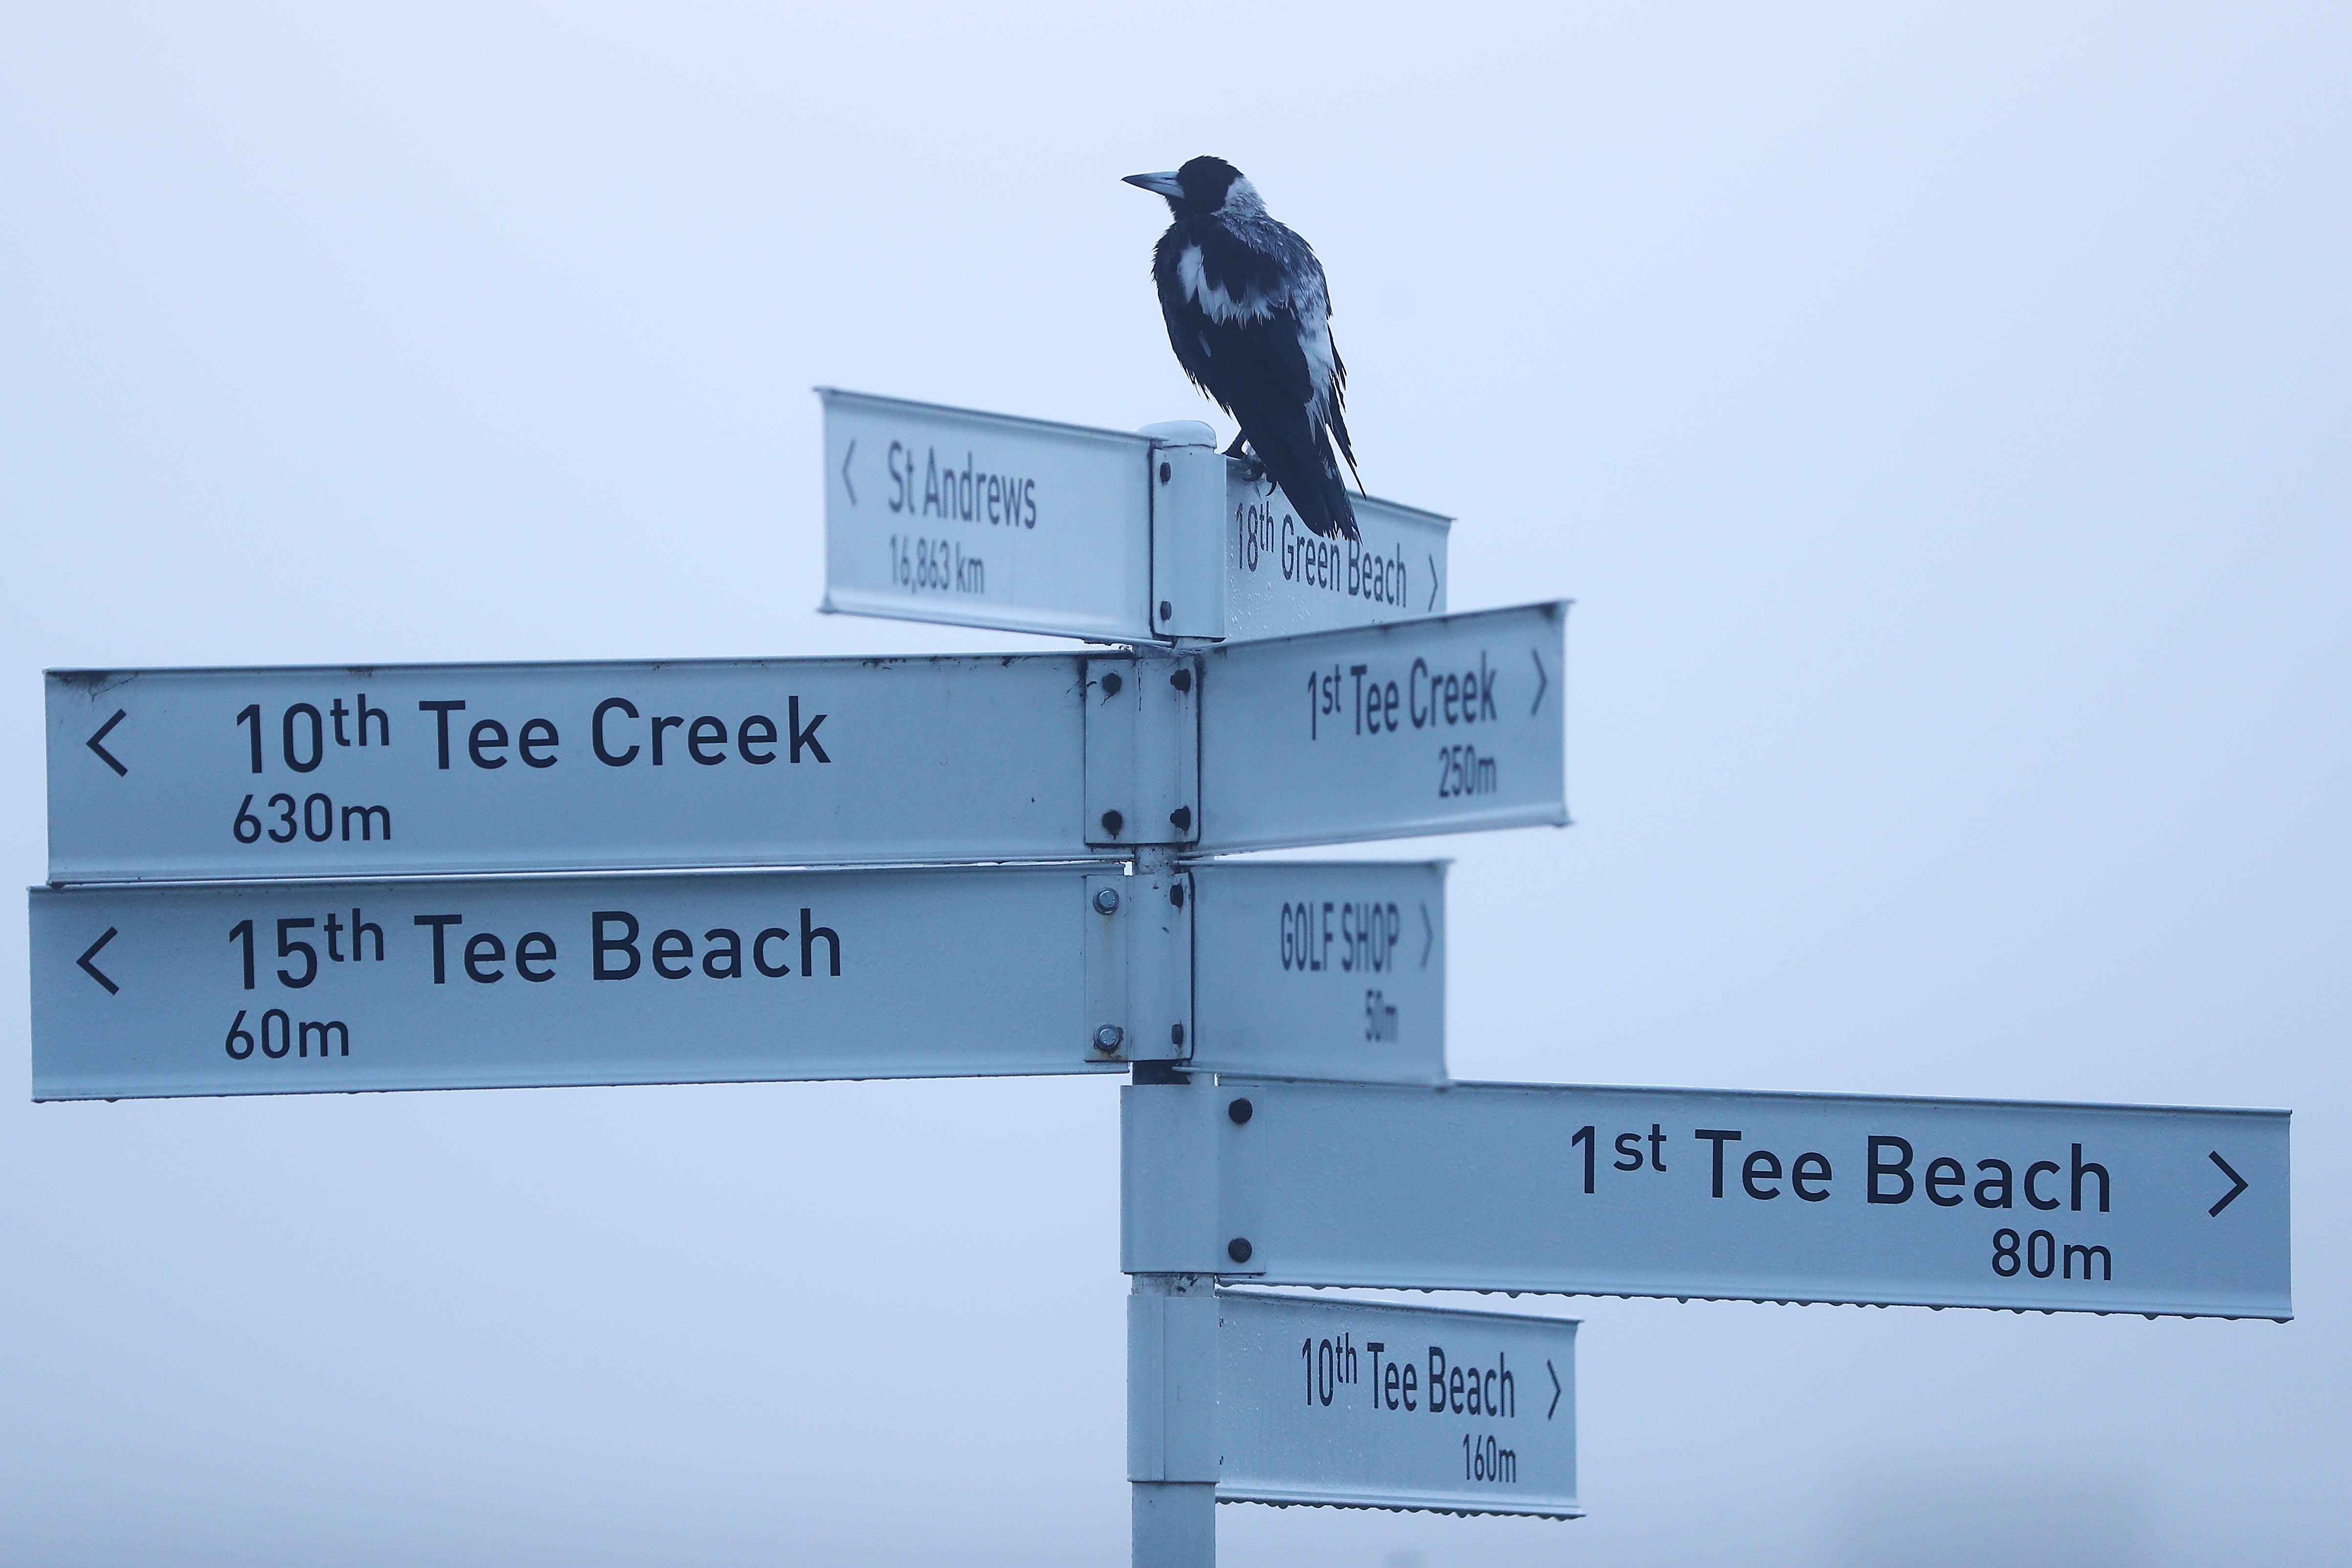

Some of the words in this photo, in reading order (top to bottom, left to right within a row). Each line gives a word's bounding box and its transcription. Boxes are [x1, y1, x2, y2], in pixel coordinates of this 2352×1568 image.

[888, 440, 915, 514] St
[923, 448, 1036, 529] Andrews
[890, 535, 950, 593] 16,863
[956, 543, 984, 593] km
[1236, 501, 1274, 572] 18th
[1282, 514, 1340, 592] Green
[1348, 539, 1406, 608] Beach
[1308, 664, 1341, 741] 1st
[1350, 664, 1399, 735] Tee
[1410, 653, 1496, 729] Creek
[237, 694, 389, 773] 10th
[419, 700, 559, 770] Tee
[592, 696, 831, 767] Creek
[1439, 745, 1495, 797] 250m
[233, 793, 390, 843] 630m
[229, 908, 384, 990] 15th
[414, 914, 556, 984] Tee
[592, 908, 840, 980] Beach
[1281, 902, 1334, 971] GOLF
[1342, 903, 1399, 973] SHOP
[226, 1009, 349, 1060] 60m
[1366, 989, 1397, 1042] 50m
[1572, 1124, 1666, 1194] 1st
[1695, 1129, 1832, 1202] Tee
[1868, 1136, 2109, 1212] Beach
[1992, 1228, 2111, 1280] 80m
[1302, 1333, 1357, 1407] 10th
[1367, 1342, 1417, 1411] Tee
[1429, 1346, 1515, 1418] Beach
[1463, 1434, 1516, 1483] 160m
